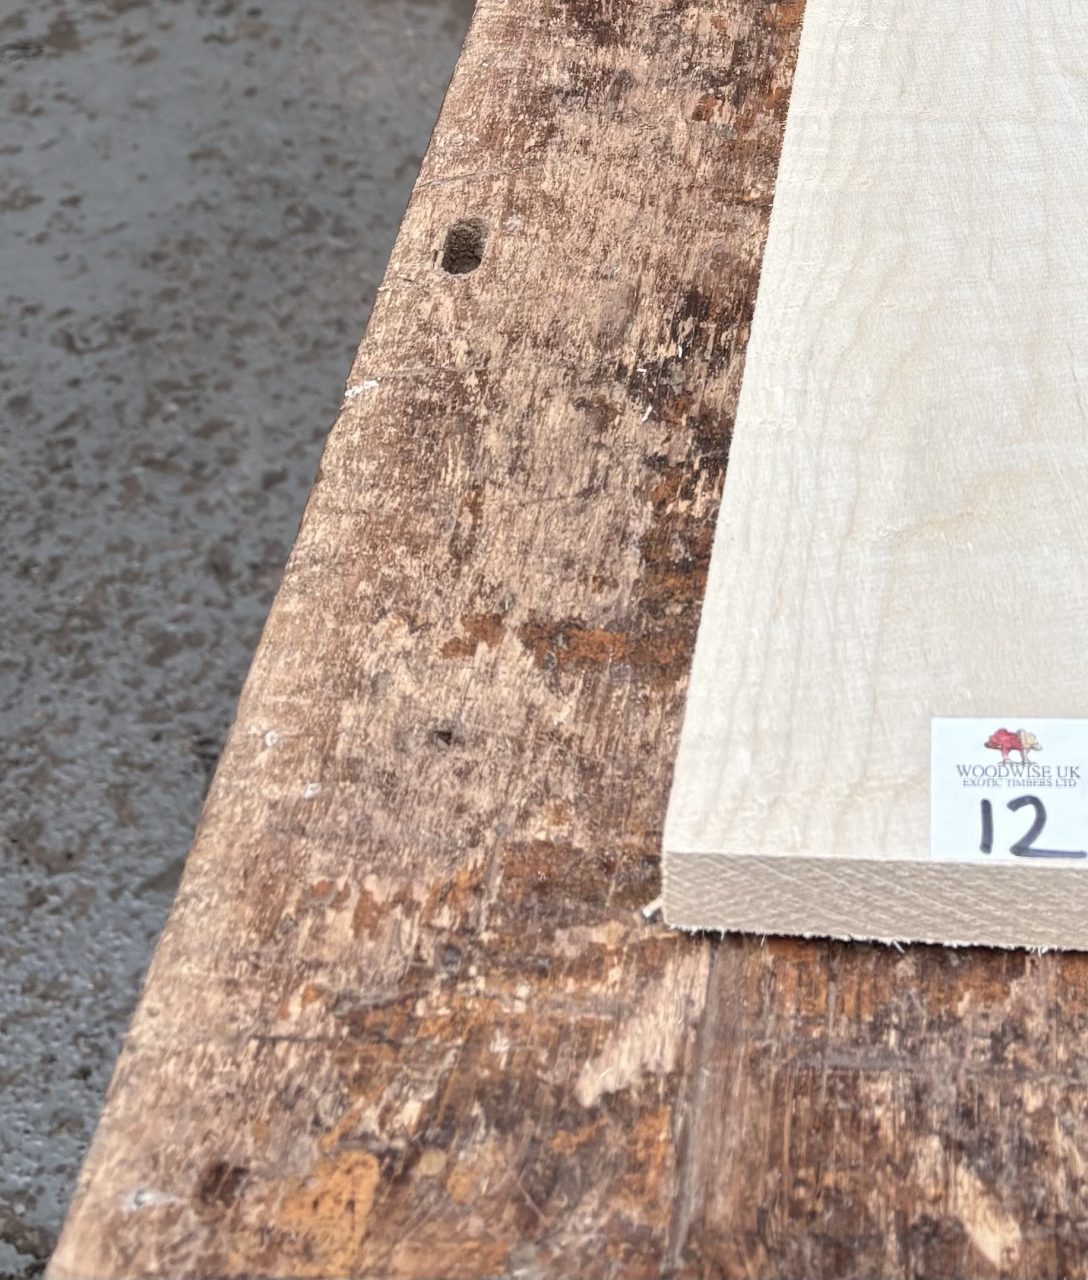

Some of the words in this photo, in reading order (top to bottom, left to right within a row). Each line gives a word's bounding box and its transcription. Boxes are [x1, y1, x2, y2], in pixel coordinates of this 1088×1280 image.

[956, 764, 1051, 778] WOODWISE
[1056, 765, 1081, 779] UK
[962, 778, 1004, 787] EXOTIC
[1006, 778, 1053, 787] TIMBERS
[1055, 778, 1077, 787] LTD
[980, 794, 1087, 858] 12
